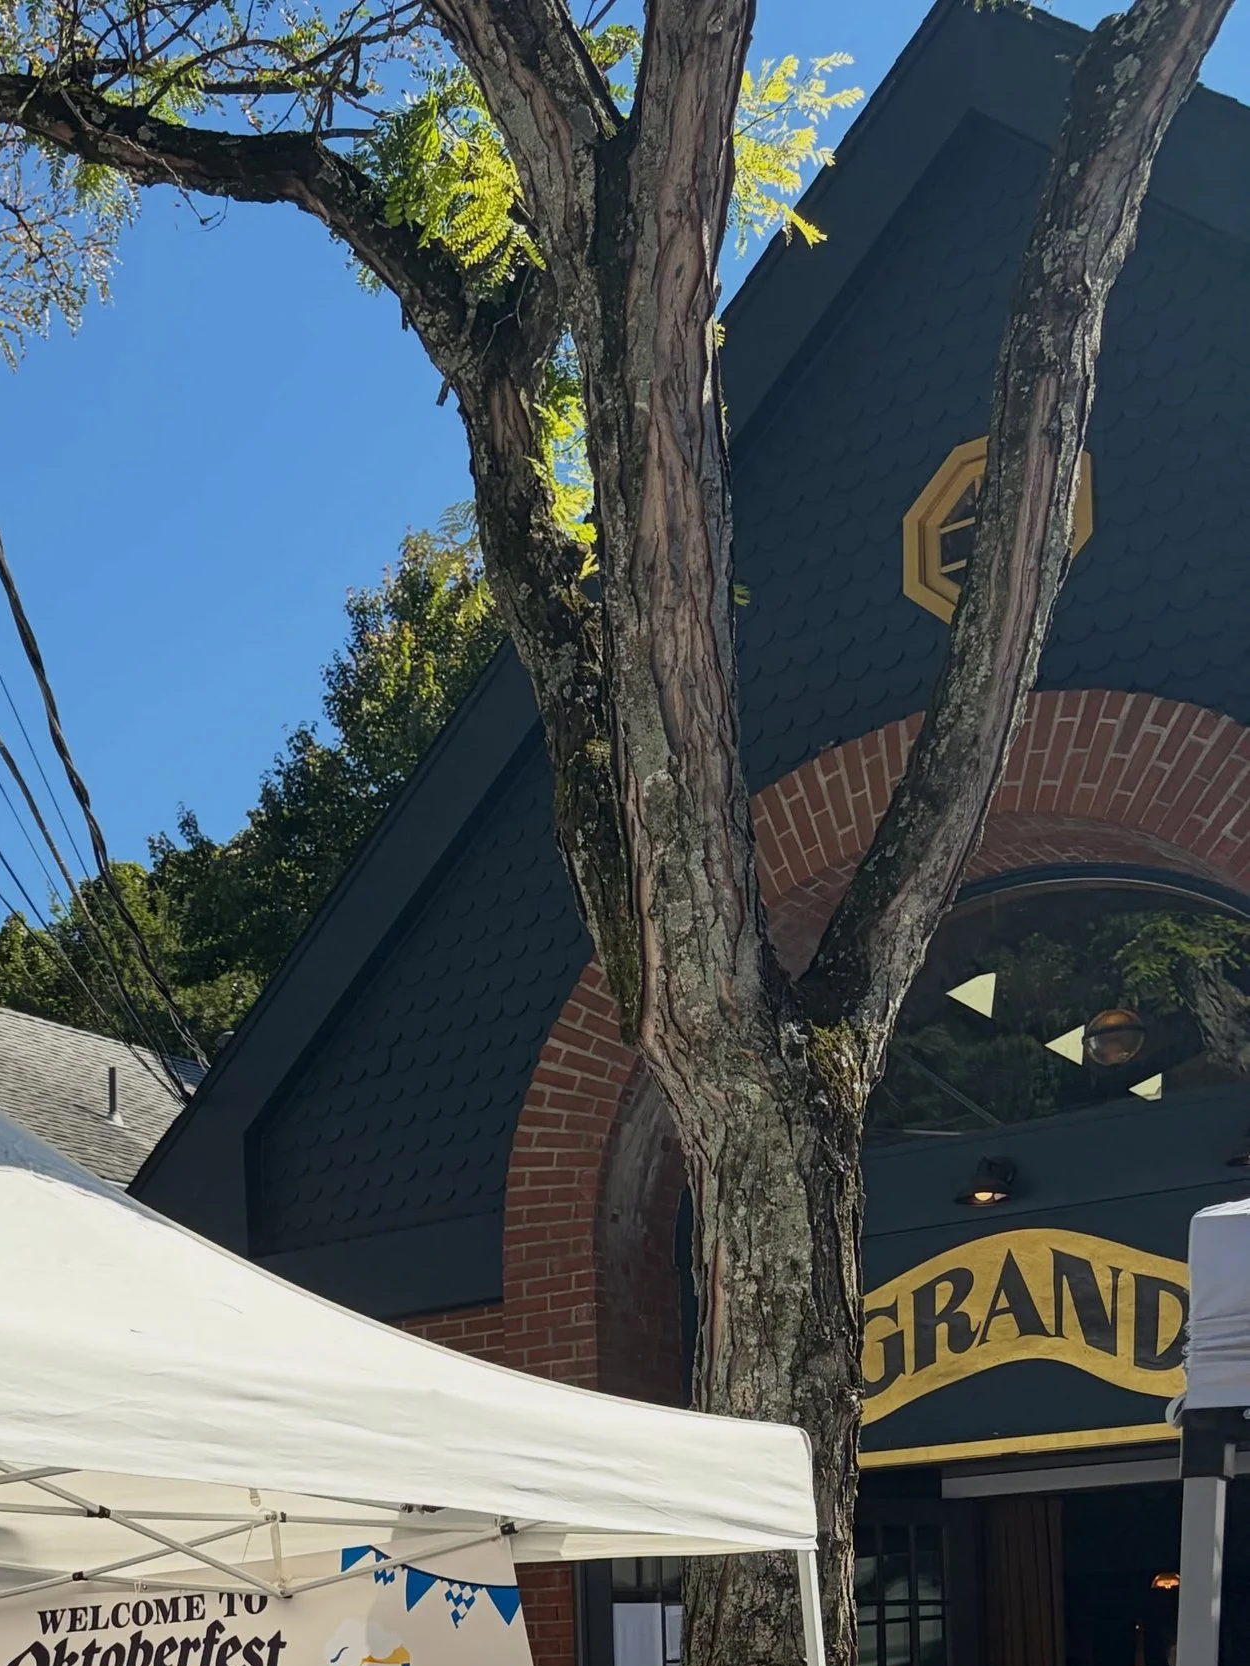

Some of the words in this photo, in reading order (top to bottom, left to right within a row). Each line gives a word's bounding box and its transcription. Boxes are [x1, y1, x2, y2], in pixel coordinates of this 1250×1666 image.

[865, 1248, 1189, 1401] GRAND
[37, 1594, 206, 1634] WELCOME
[219, 1592, 268, 1618] TO
